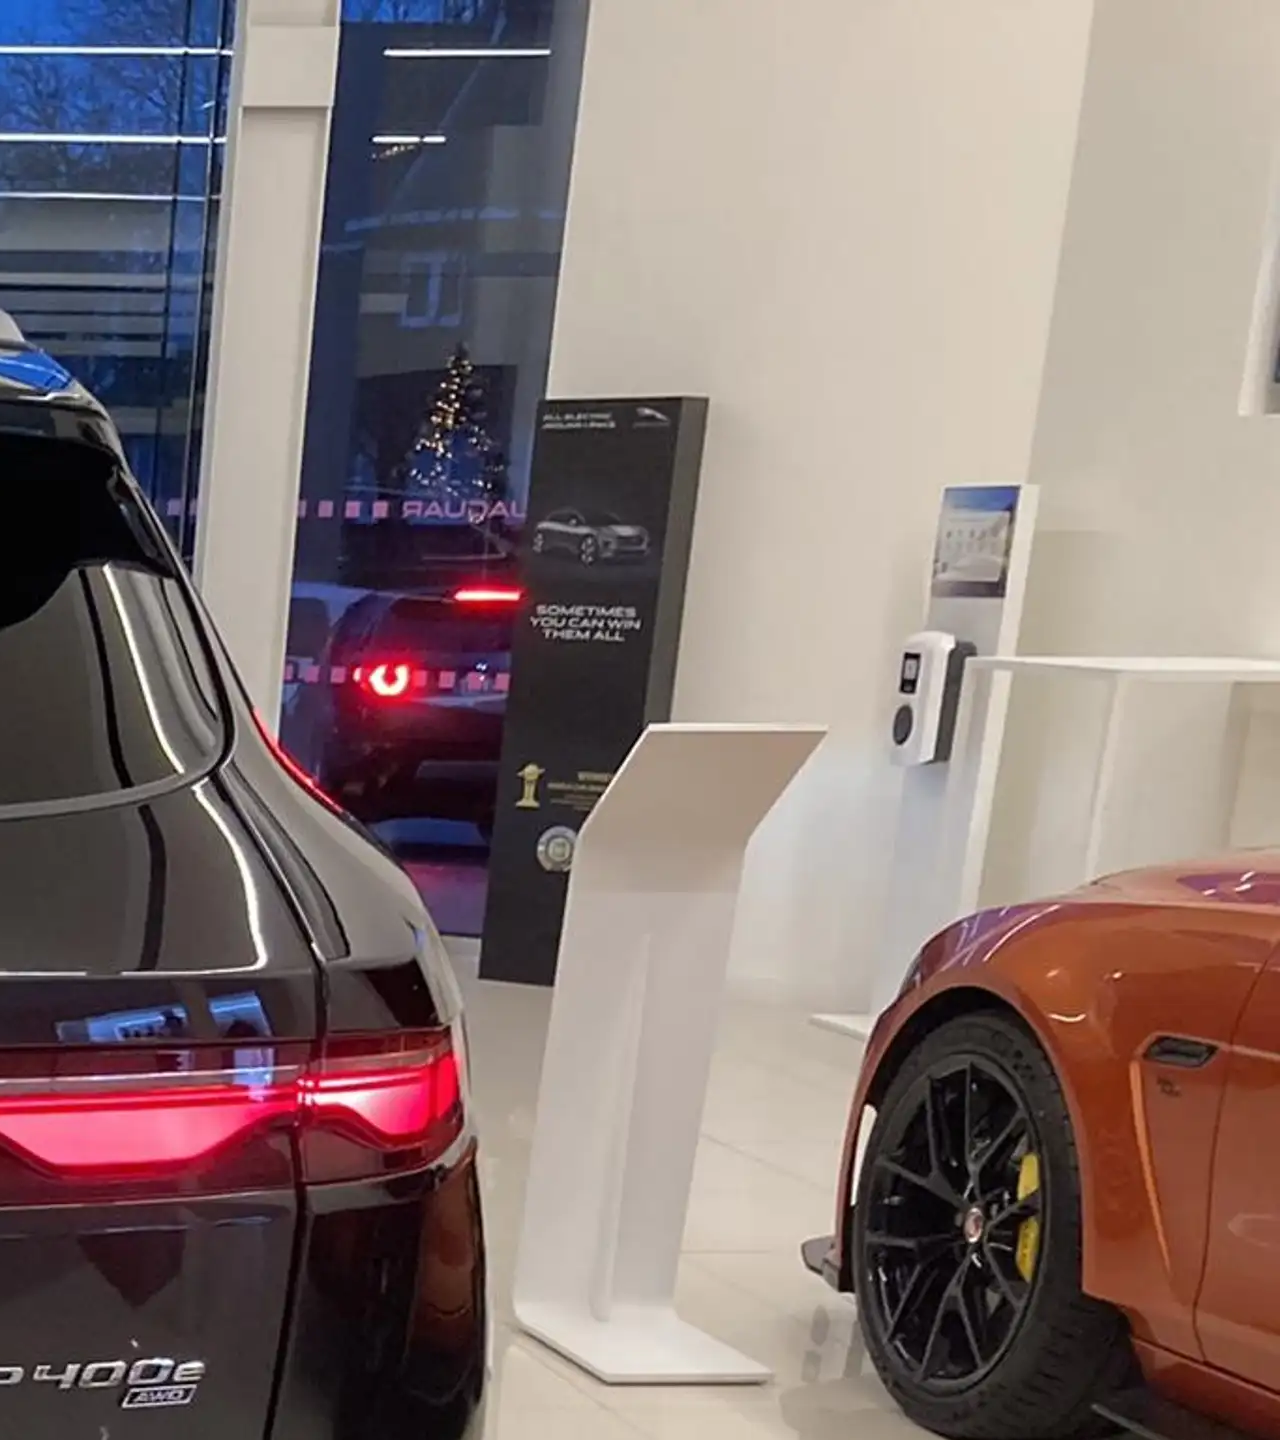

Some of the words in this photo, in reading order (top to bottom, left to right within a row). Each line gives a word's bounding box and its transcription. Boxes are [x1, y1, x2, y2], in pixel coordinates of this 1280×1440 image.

[536, 604, 636, 618] SOMETIMES
[530, 616, 566, 628] YOU
[568, 617, 605, 629] CAN
[607, 618, 640, 631] WIN
[543, 628, 591, 640] THEM
[592, 631, 625, 643] ALL
